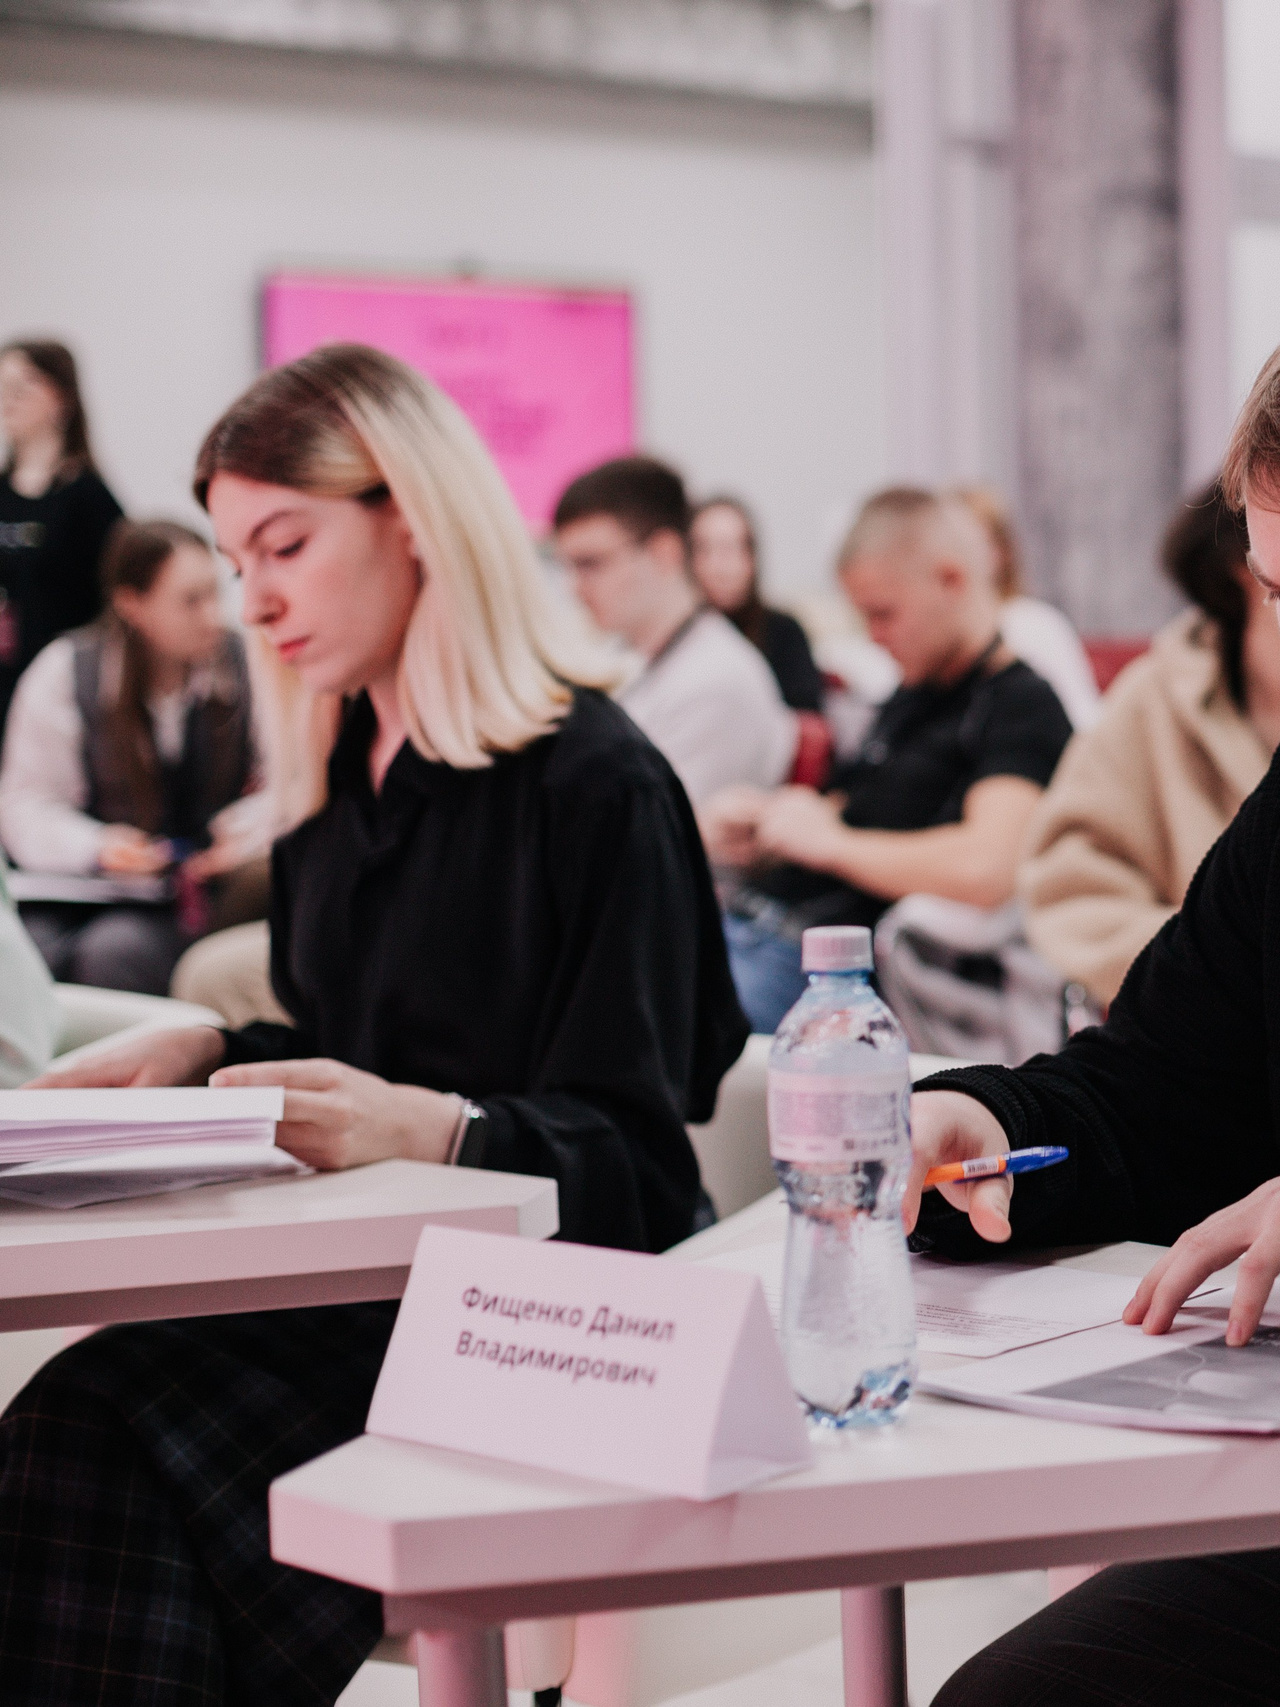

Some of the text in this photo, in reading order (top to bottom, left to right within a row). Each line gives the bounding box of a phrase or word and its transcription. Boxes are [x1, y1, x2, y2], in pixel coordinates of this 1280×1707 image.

[462, 1286, 675, 1343] Фищенко Данил
[455, 1330, 657, 1388] Владимирович
